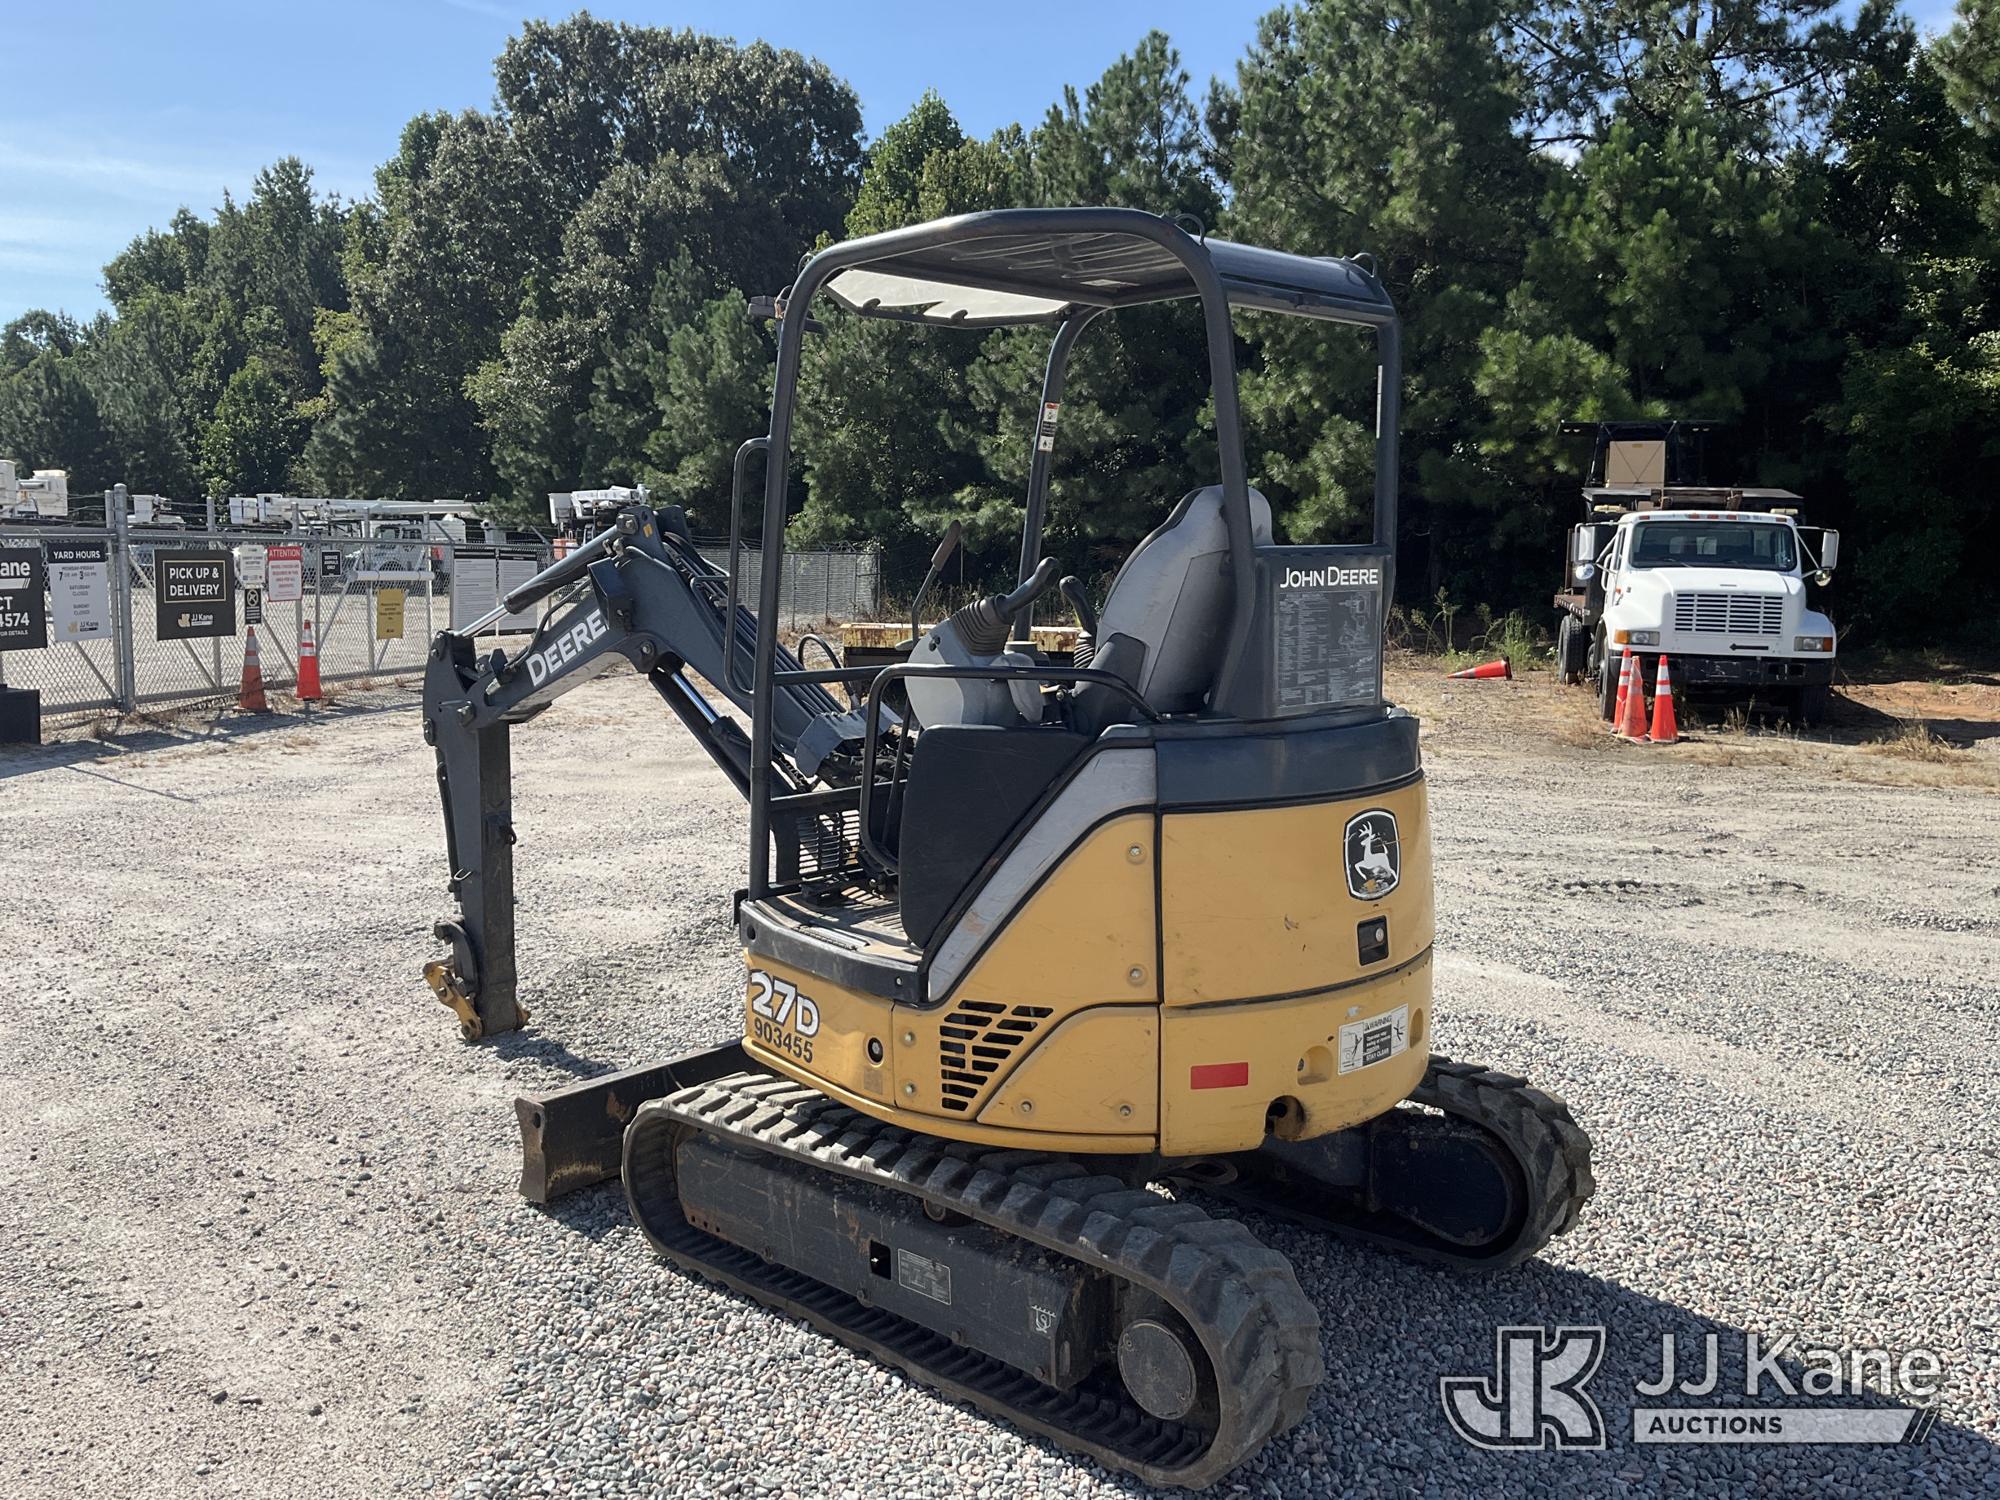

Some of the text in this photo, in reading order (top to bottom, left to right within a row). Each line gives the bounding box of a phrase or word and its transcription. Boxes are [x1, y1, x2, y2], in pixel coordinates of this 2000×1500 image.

[53, 550, 101, 559] YARD HOURS
[269, 549, 300, 558] ATTENTION
[0, 562, 31, 576] ane
[169, 567, 220, 579] PICK UP &
[1279, 566, 1379, 588] JOHN DEERE
[169, 583, 220, 597] DELIVERY
[526, 608, 607, 687] DEERE
[749, 968, 820, 1038] 27D
[754, 1016, 814, 1064] 903455
